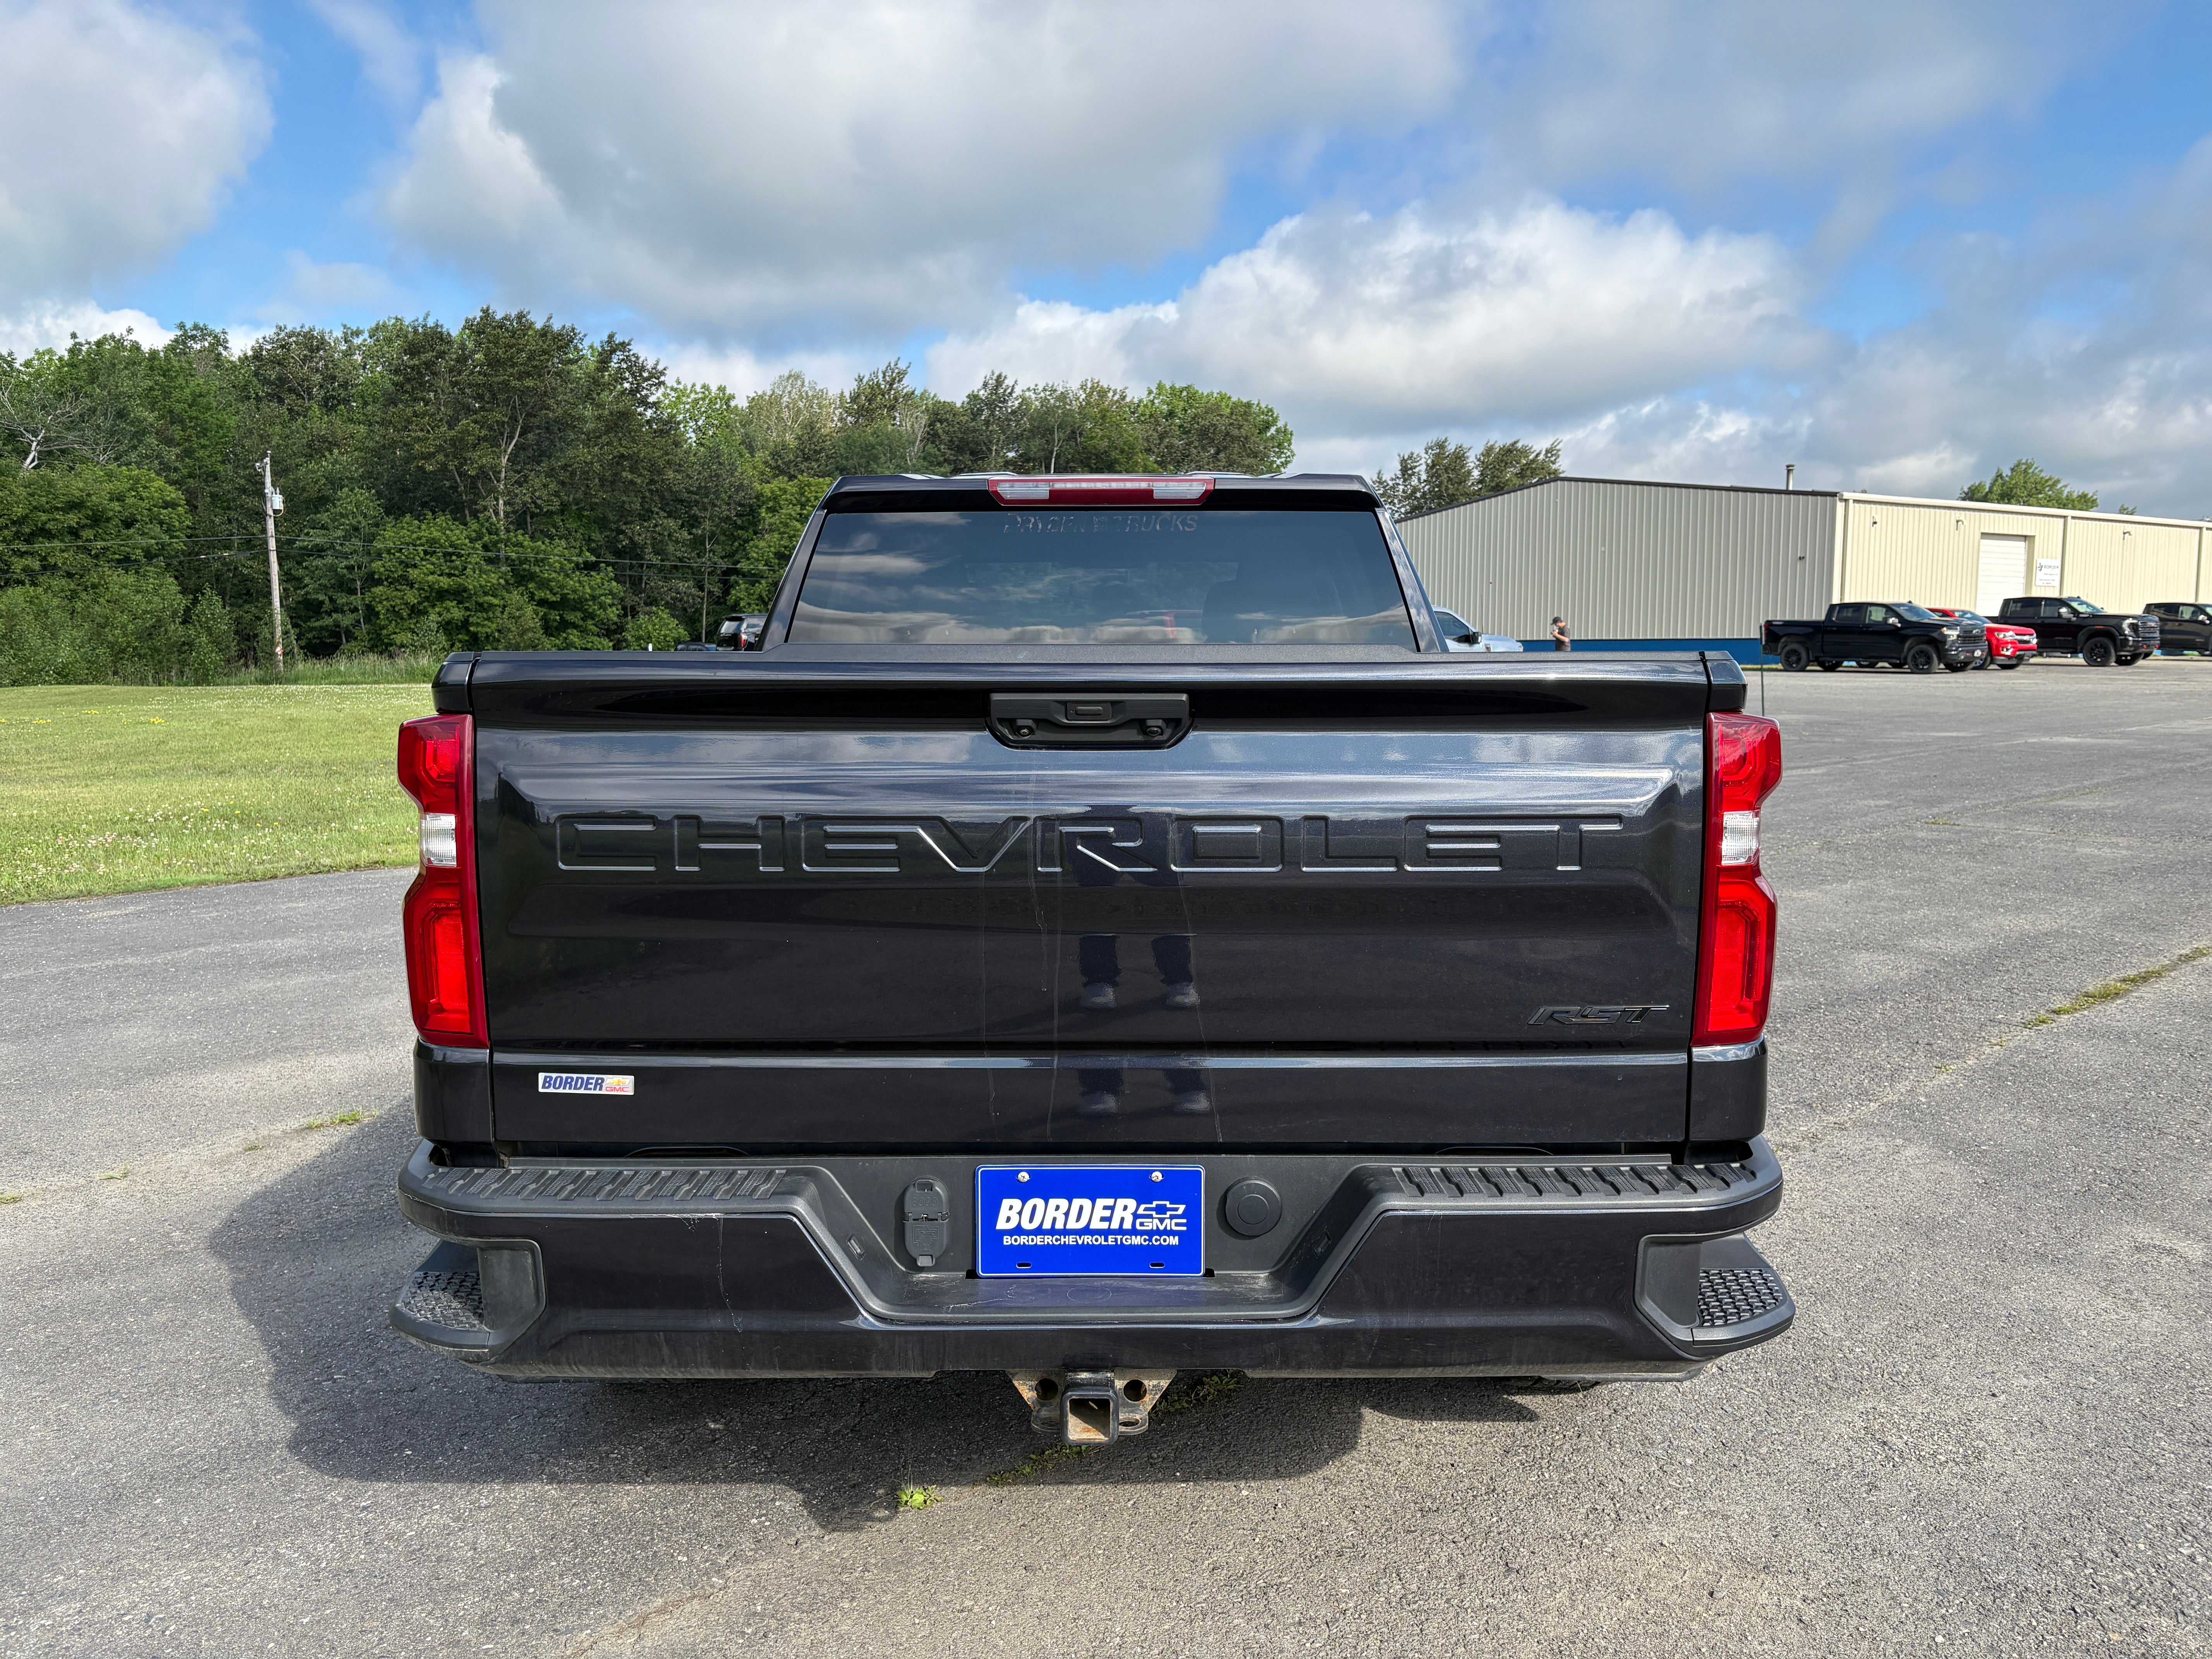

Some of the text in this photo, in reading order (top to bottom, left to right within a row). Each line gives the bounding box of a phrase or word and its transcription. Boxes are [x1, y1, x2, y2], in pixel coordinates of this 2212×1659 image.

[555, 813, 1624, 872] CHEVROLET
[1527, 1005, 1670, 1025] RST
[541, 1075, 605, 1091] BORDER
[996, 1198, 1187, 1231] BORDER GMC
[1003, 1235, 1179, 1245] BORDERCHEVROLETGMC.COM
